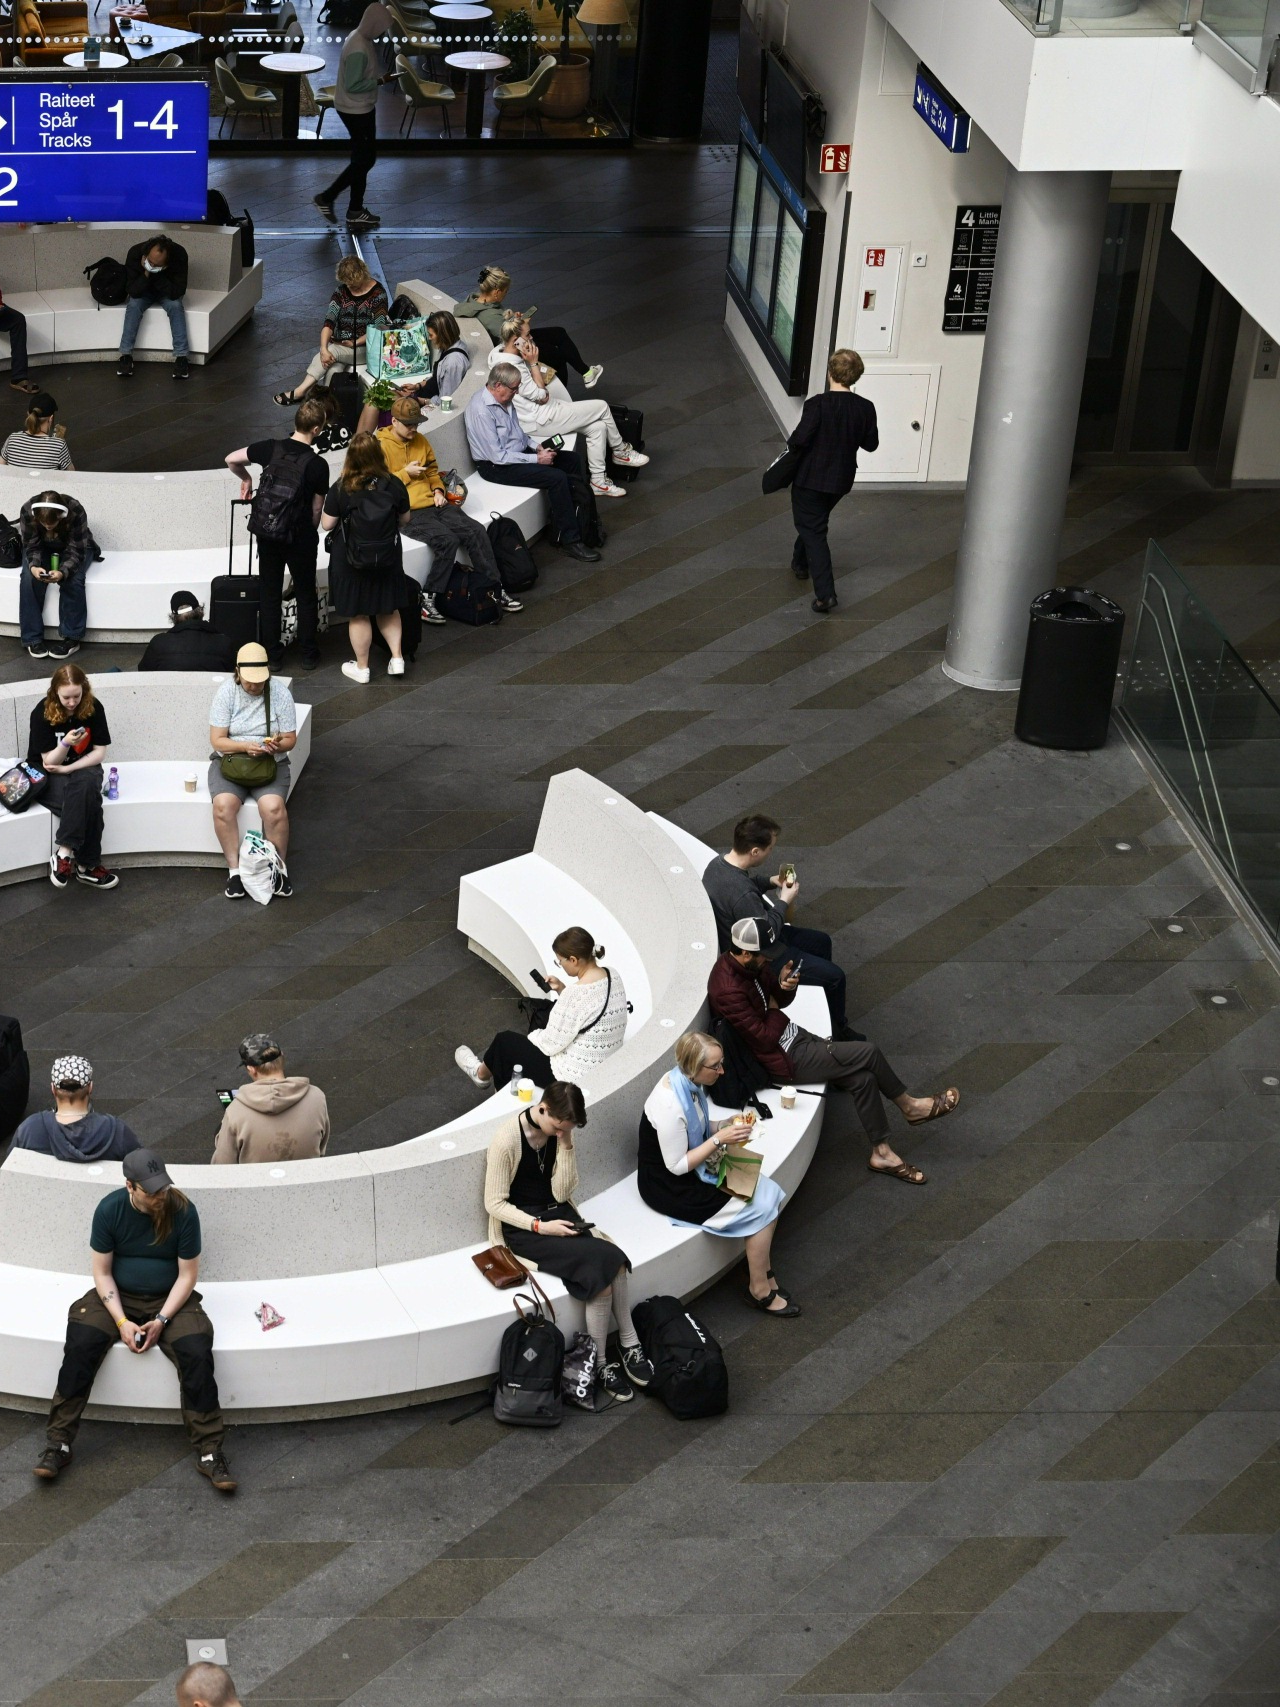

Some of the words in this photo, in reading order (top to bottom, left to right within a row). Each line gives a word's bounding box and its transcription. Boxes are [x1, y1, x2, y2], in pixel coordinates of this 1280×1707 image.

[40, 92, 95, 107] Raiteet
[40, 112, 78, 130] Spår
[107, 99, 179, 140] 1-4
[39, 132, 92, 147] Tracks
[961, 210, 975, 226] 4
[953, 284, 962, 294] 4
